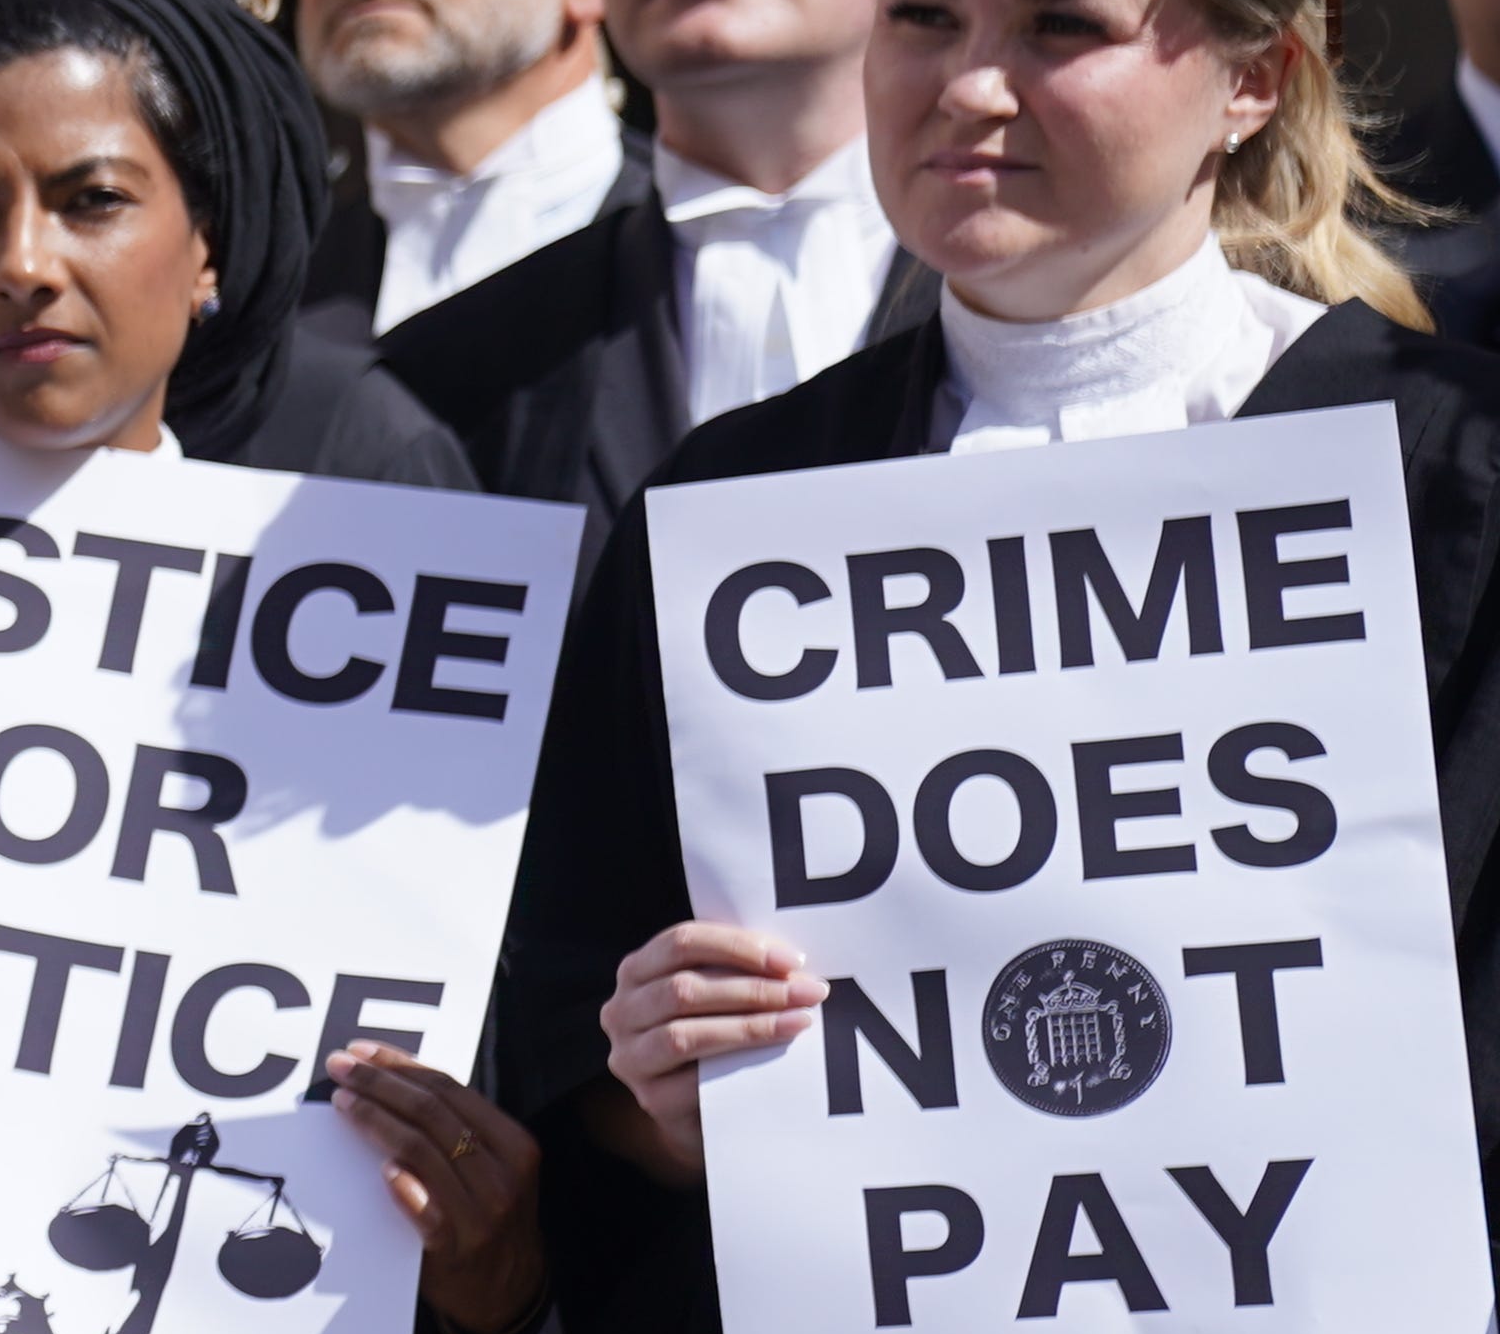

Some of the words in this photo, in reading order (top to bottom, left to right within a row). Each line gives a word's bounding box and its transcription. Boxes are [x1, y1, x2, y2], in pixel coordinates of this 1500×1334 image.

[703, 498, 1366, 701] CRIME
[763, 721, 1338, 910] DOES
[861, 1157, 1314, 1328] PAY
